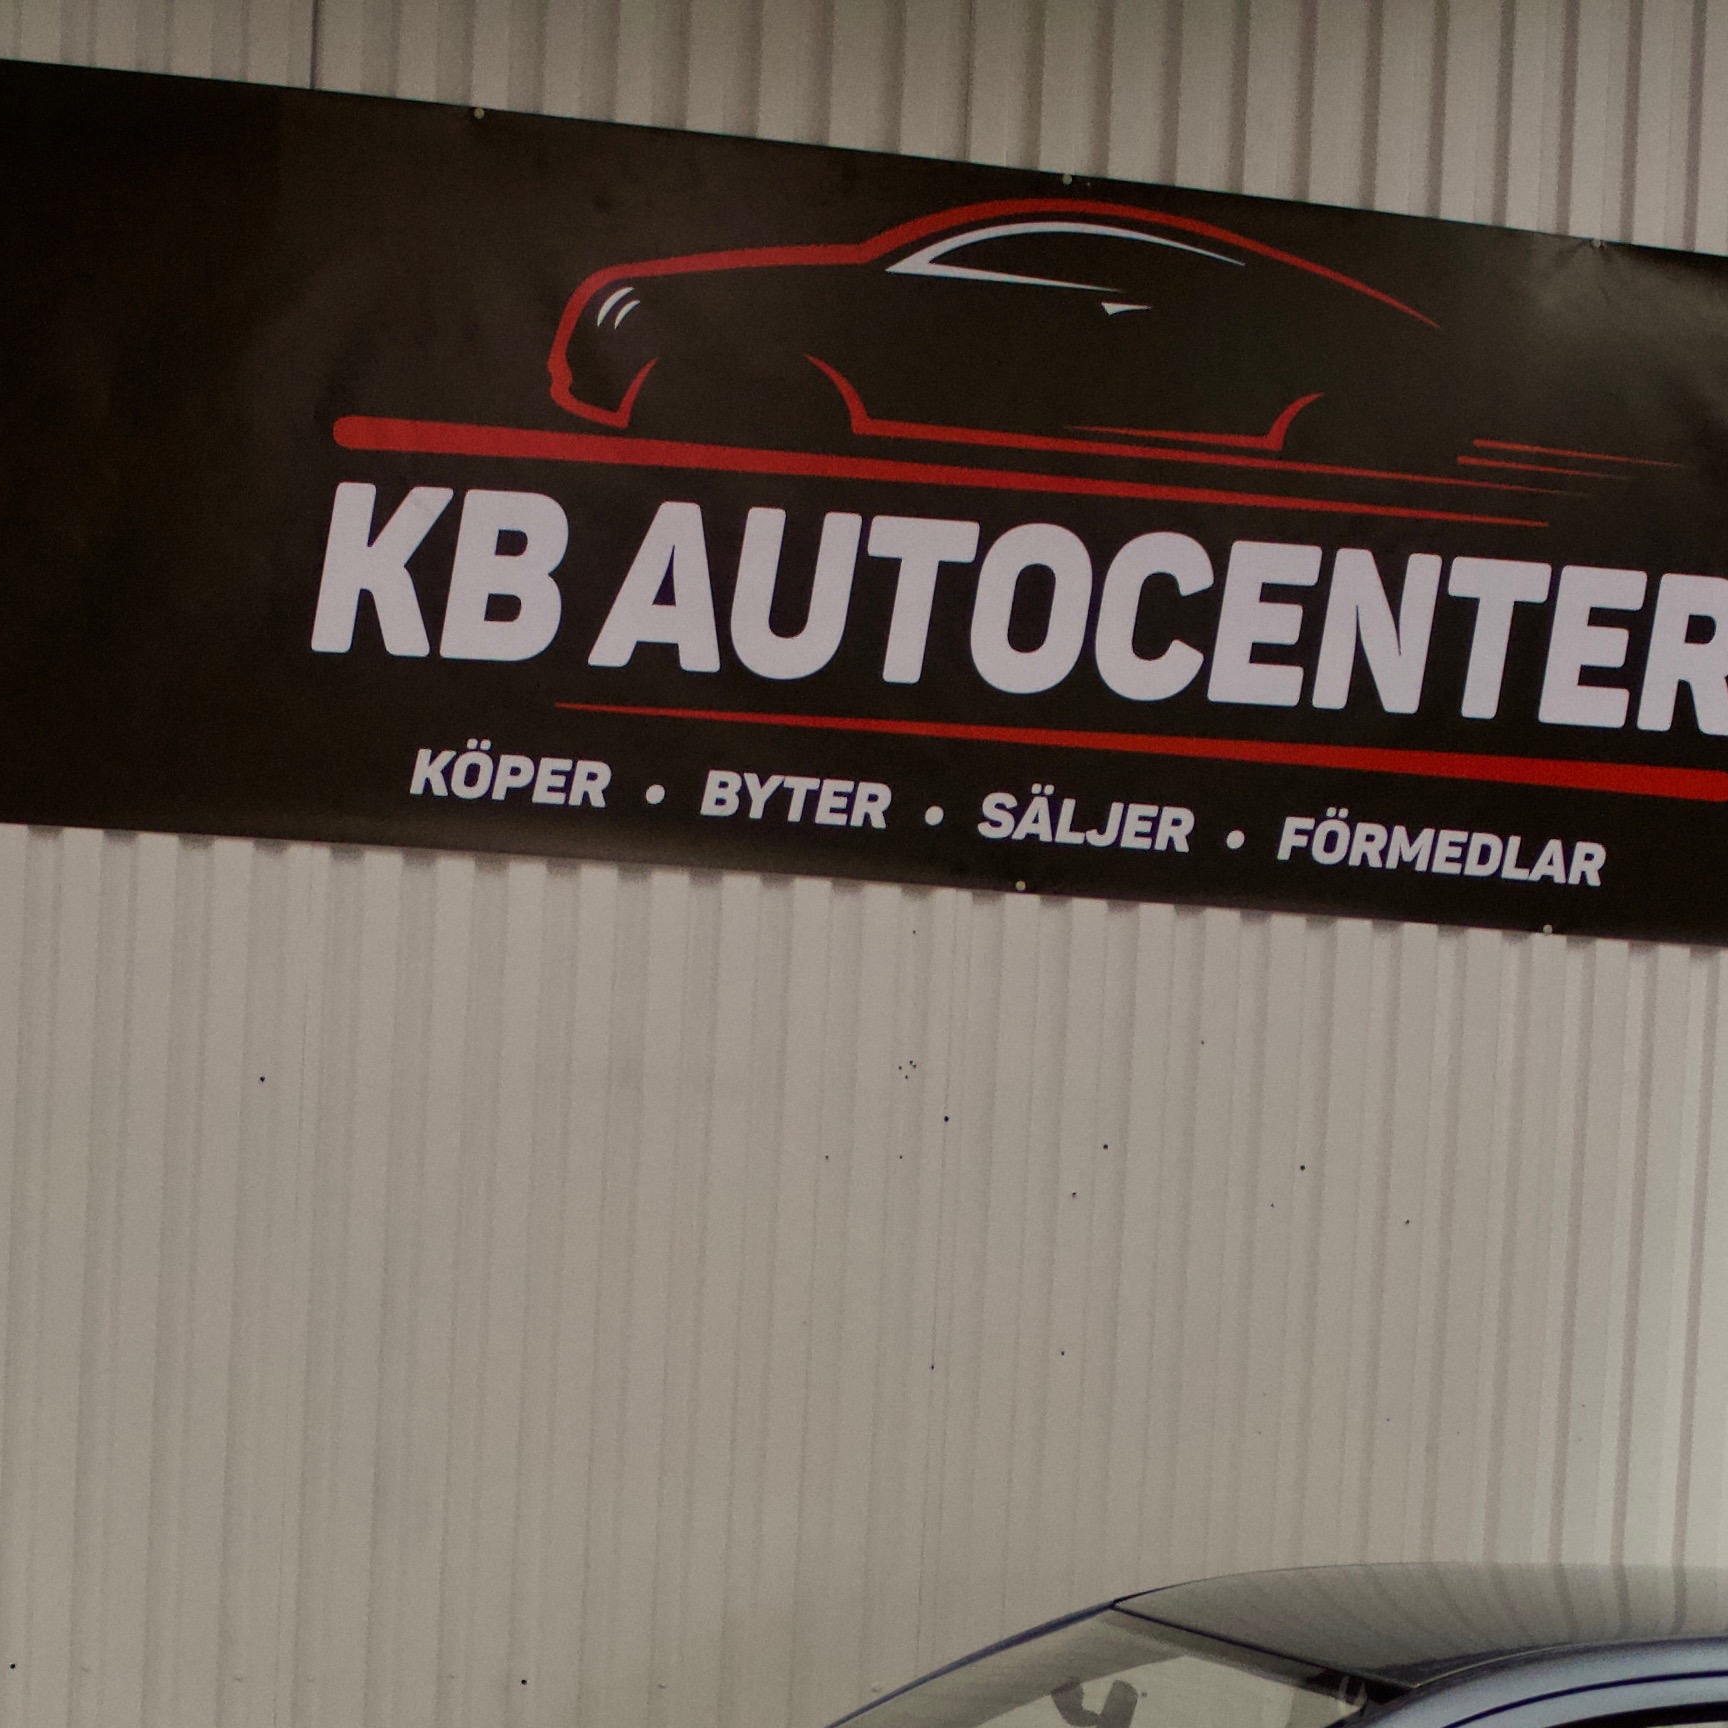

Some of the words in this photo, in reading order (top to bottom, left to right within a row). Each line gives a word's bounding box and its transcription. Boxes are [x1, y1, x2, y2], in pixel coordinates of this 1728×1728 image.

[310, 481, 571, 662] KB
[408, 738, 613, 809] KÖPER
[699, 769, 893, 830] BYTER
[976, 783, 1196, 854] SÄLJER
[1276, 806, 1607, 888] FÖRMEDLAR
